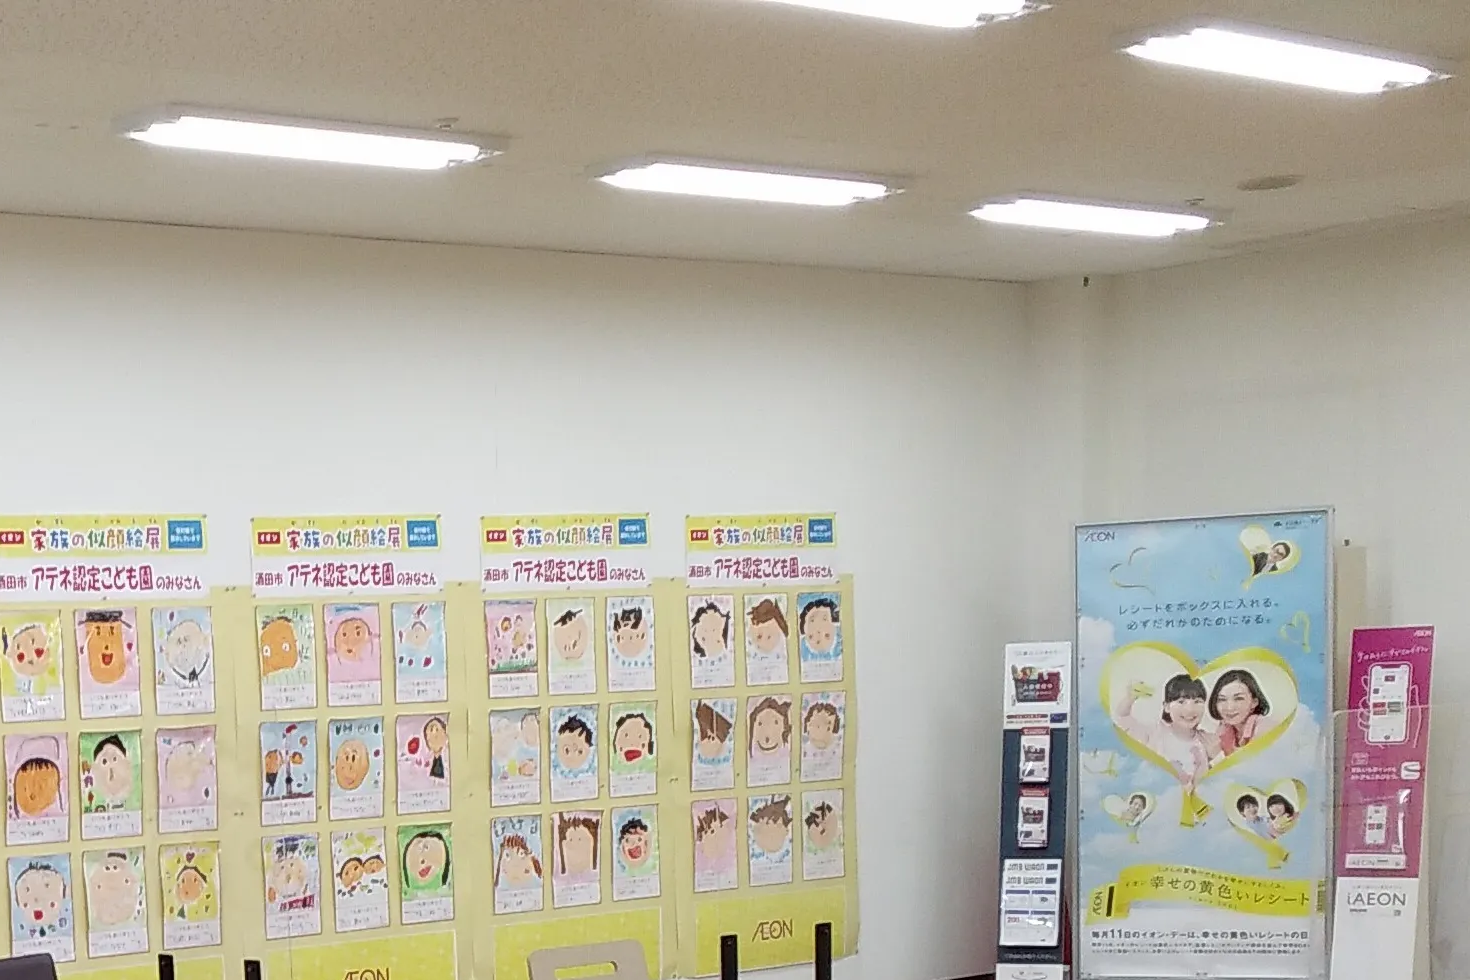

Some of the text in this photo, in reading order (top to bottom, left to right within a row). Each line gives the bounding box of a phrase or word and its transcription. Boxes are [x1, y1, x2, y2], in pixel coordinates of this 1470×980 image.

[31, 528, 160, 550] 家族の似顔絵展
[287, 527, 400, 550] 家族の似顔絵展
[512, 525, 612, 547] 家族の似顔絵展
[713, 525, 803, 545] 家族の似顔絵展
[31, 565, 152, 591] アテネ認定こども園
[156, 576, 201, 590] のみなさん
[287, 562, 394, 587] アテネ認定こども園
[397, 572, 436, 586] のみなさん
[512, 559, 607, 583] アテネ認定こども園
[609, 568, 646, 580] のみなさん
[1127, 616, 1271, 631] 必ずだれかのためになる。
[1150, 876, 1310, 906] 幸せの黄色いレシート
[1347, 892, 1406, 906] iAEON
